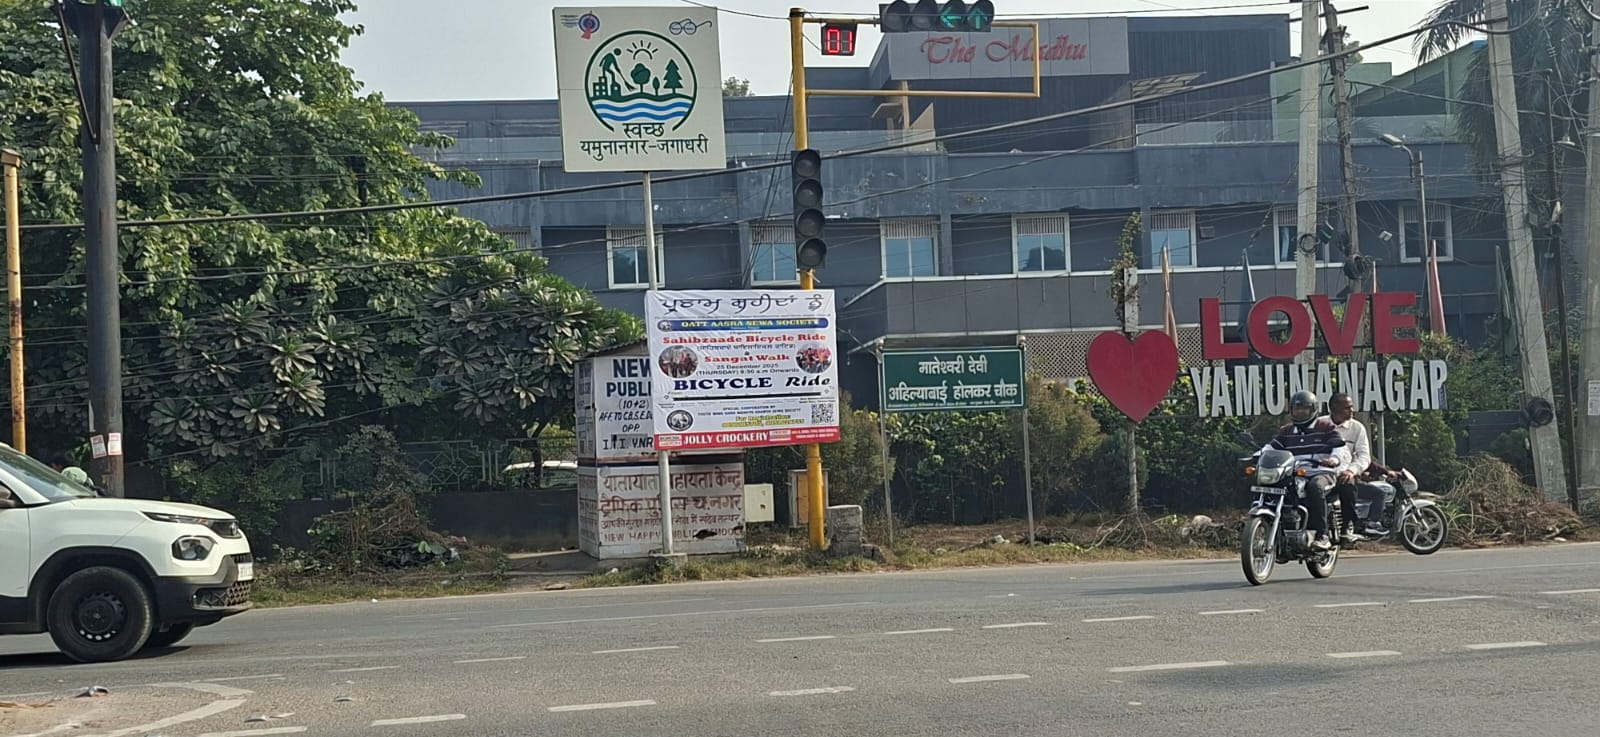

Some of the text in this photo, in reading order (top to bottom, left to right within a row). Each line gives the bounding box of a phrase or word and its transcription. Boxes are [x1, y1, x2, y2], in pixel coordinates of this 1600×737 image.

[825, 28, 853, 54] 01
[920, 36, 977, 64] The
[622, 122, 665, 139] स्वच्छ
[579, 133, 709, 162] यमुनानगर-जगाधरी
[1201, 291, 1421, 360] LOVE
[663, 332, 826, 345] Sahibzaade Bicycle Ride
[613, 358, 651, 378] NEW
[704, 353, 790, 363] Sangat Walk
[918, 354, 988, 375] मातेश्वरी देवी
[696, 368, 739, 376] (THURSDAY)
[673, 375, 831, 392] BICYCLE Ride
[888, 380, 948, 404] अहिल्याबाई
[953, 379, 992, 400] होलकर
[993, 378, 1018, 398] चौक
[684, 433, 713, 445] JOLLY
[716, 431, 768, 444] CROCKERY
[669, 470, 713, 492] हायता
